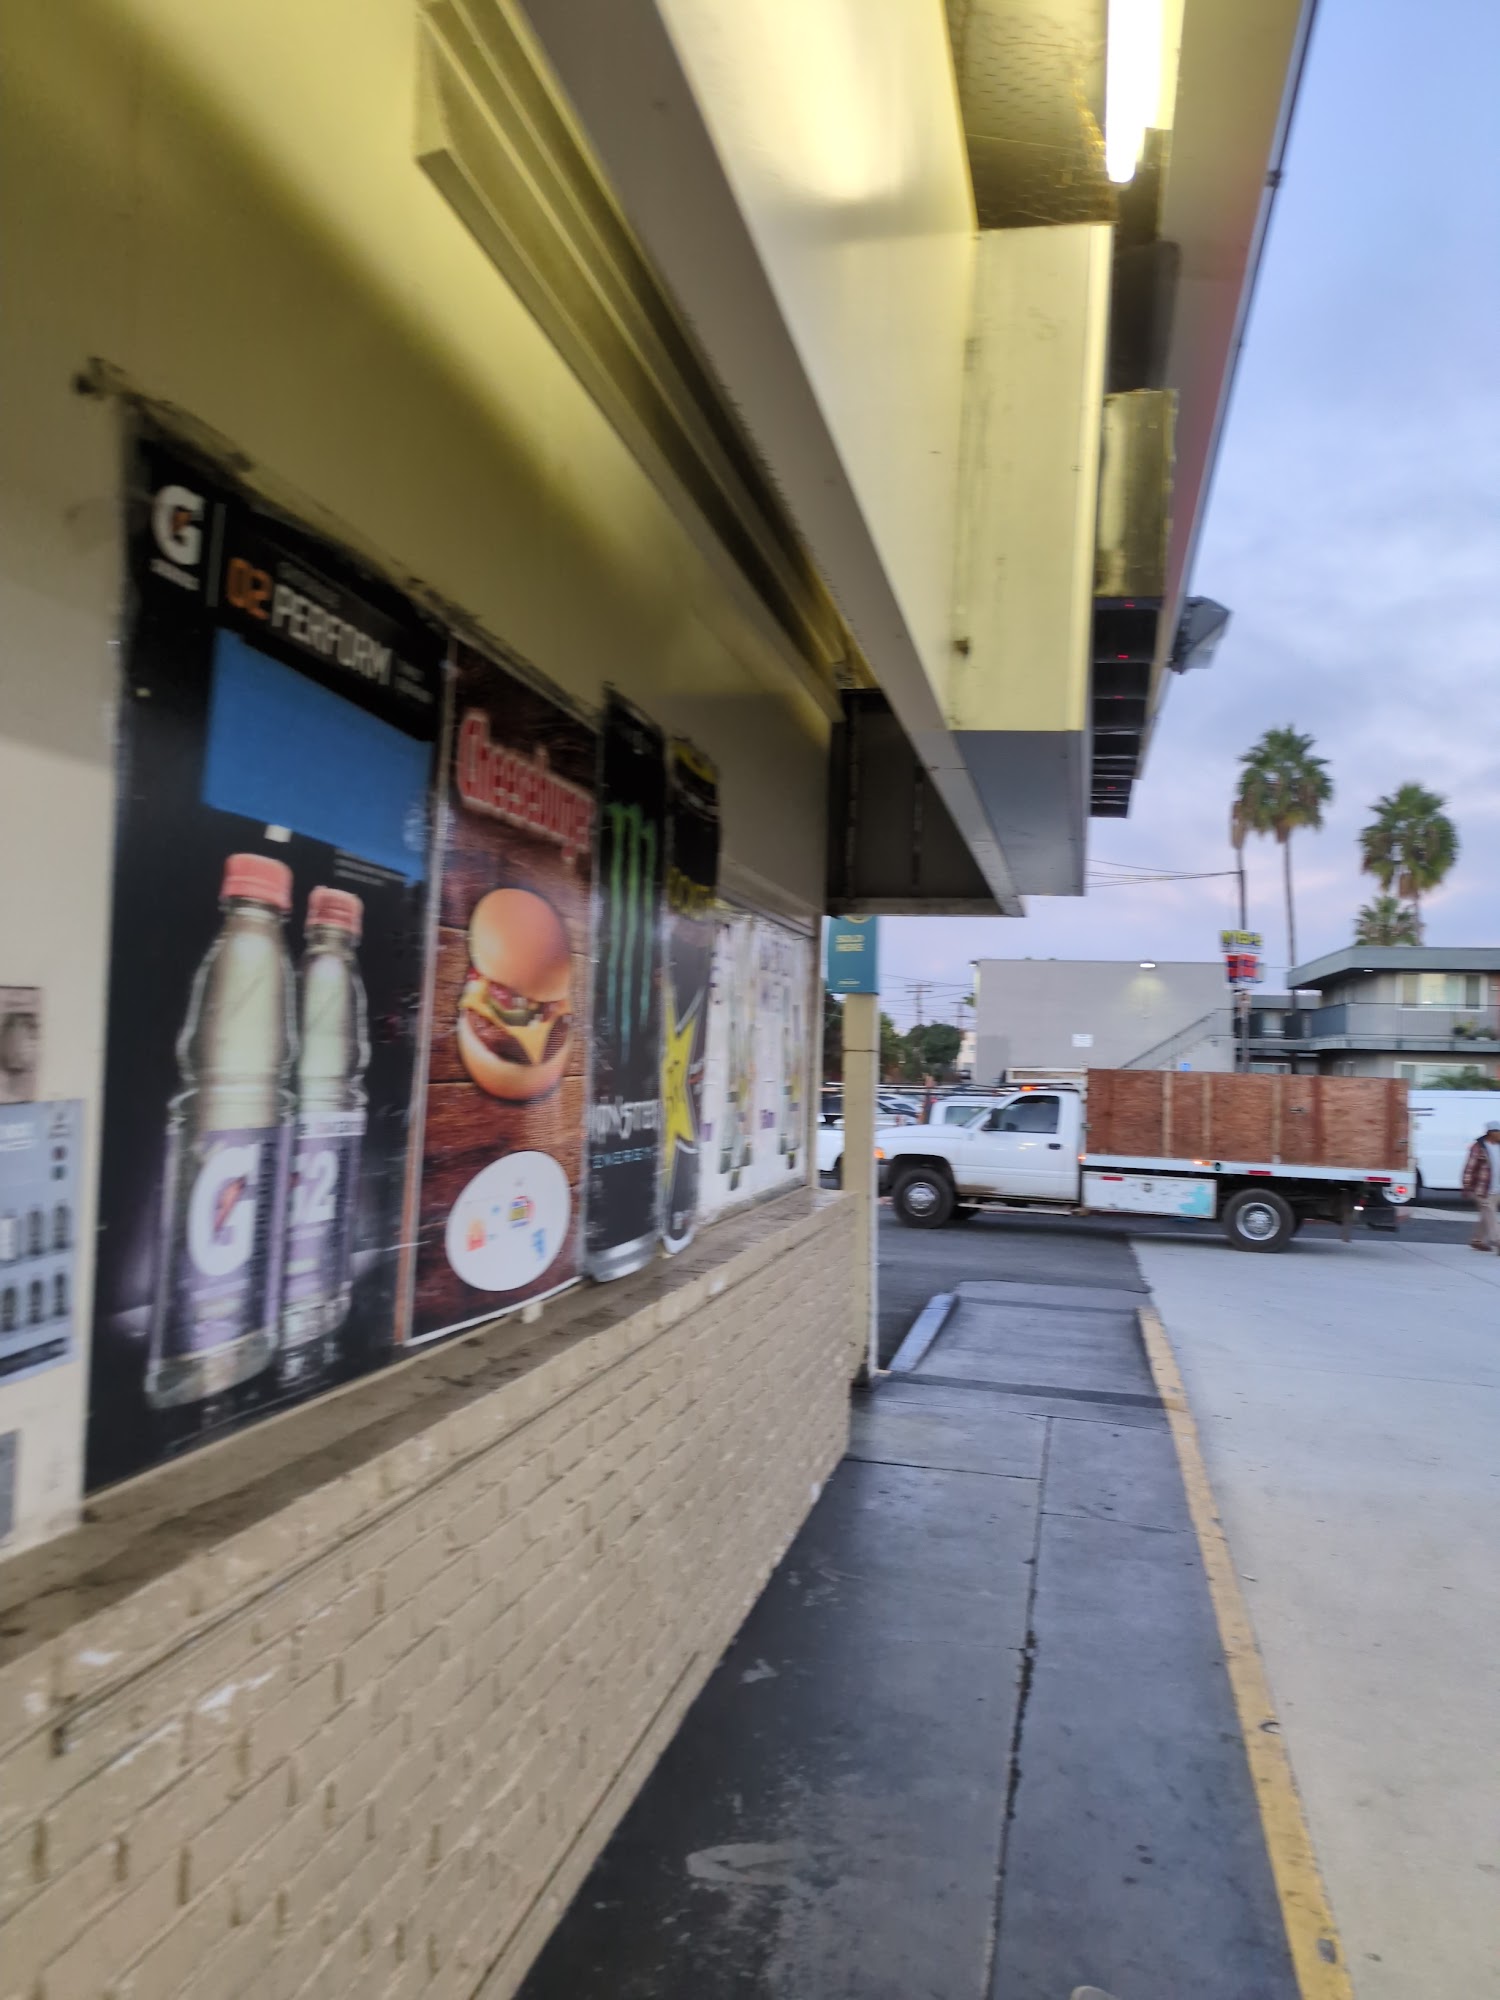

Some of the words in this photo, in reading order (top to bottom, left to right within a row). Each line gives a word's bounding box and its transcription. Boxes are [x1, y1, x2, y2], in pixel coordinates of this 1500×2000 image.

[152, 485, 205, 566] G
[271, 584, 392, 686] PERFORM
[187, 1142, 262, 1277] G
